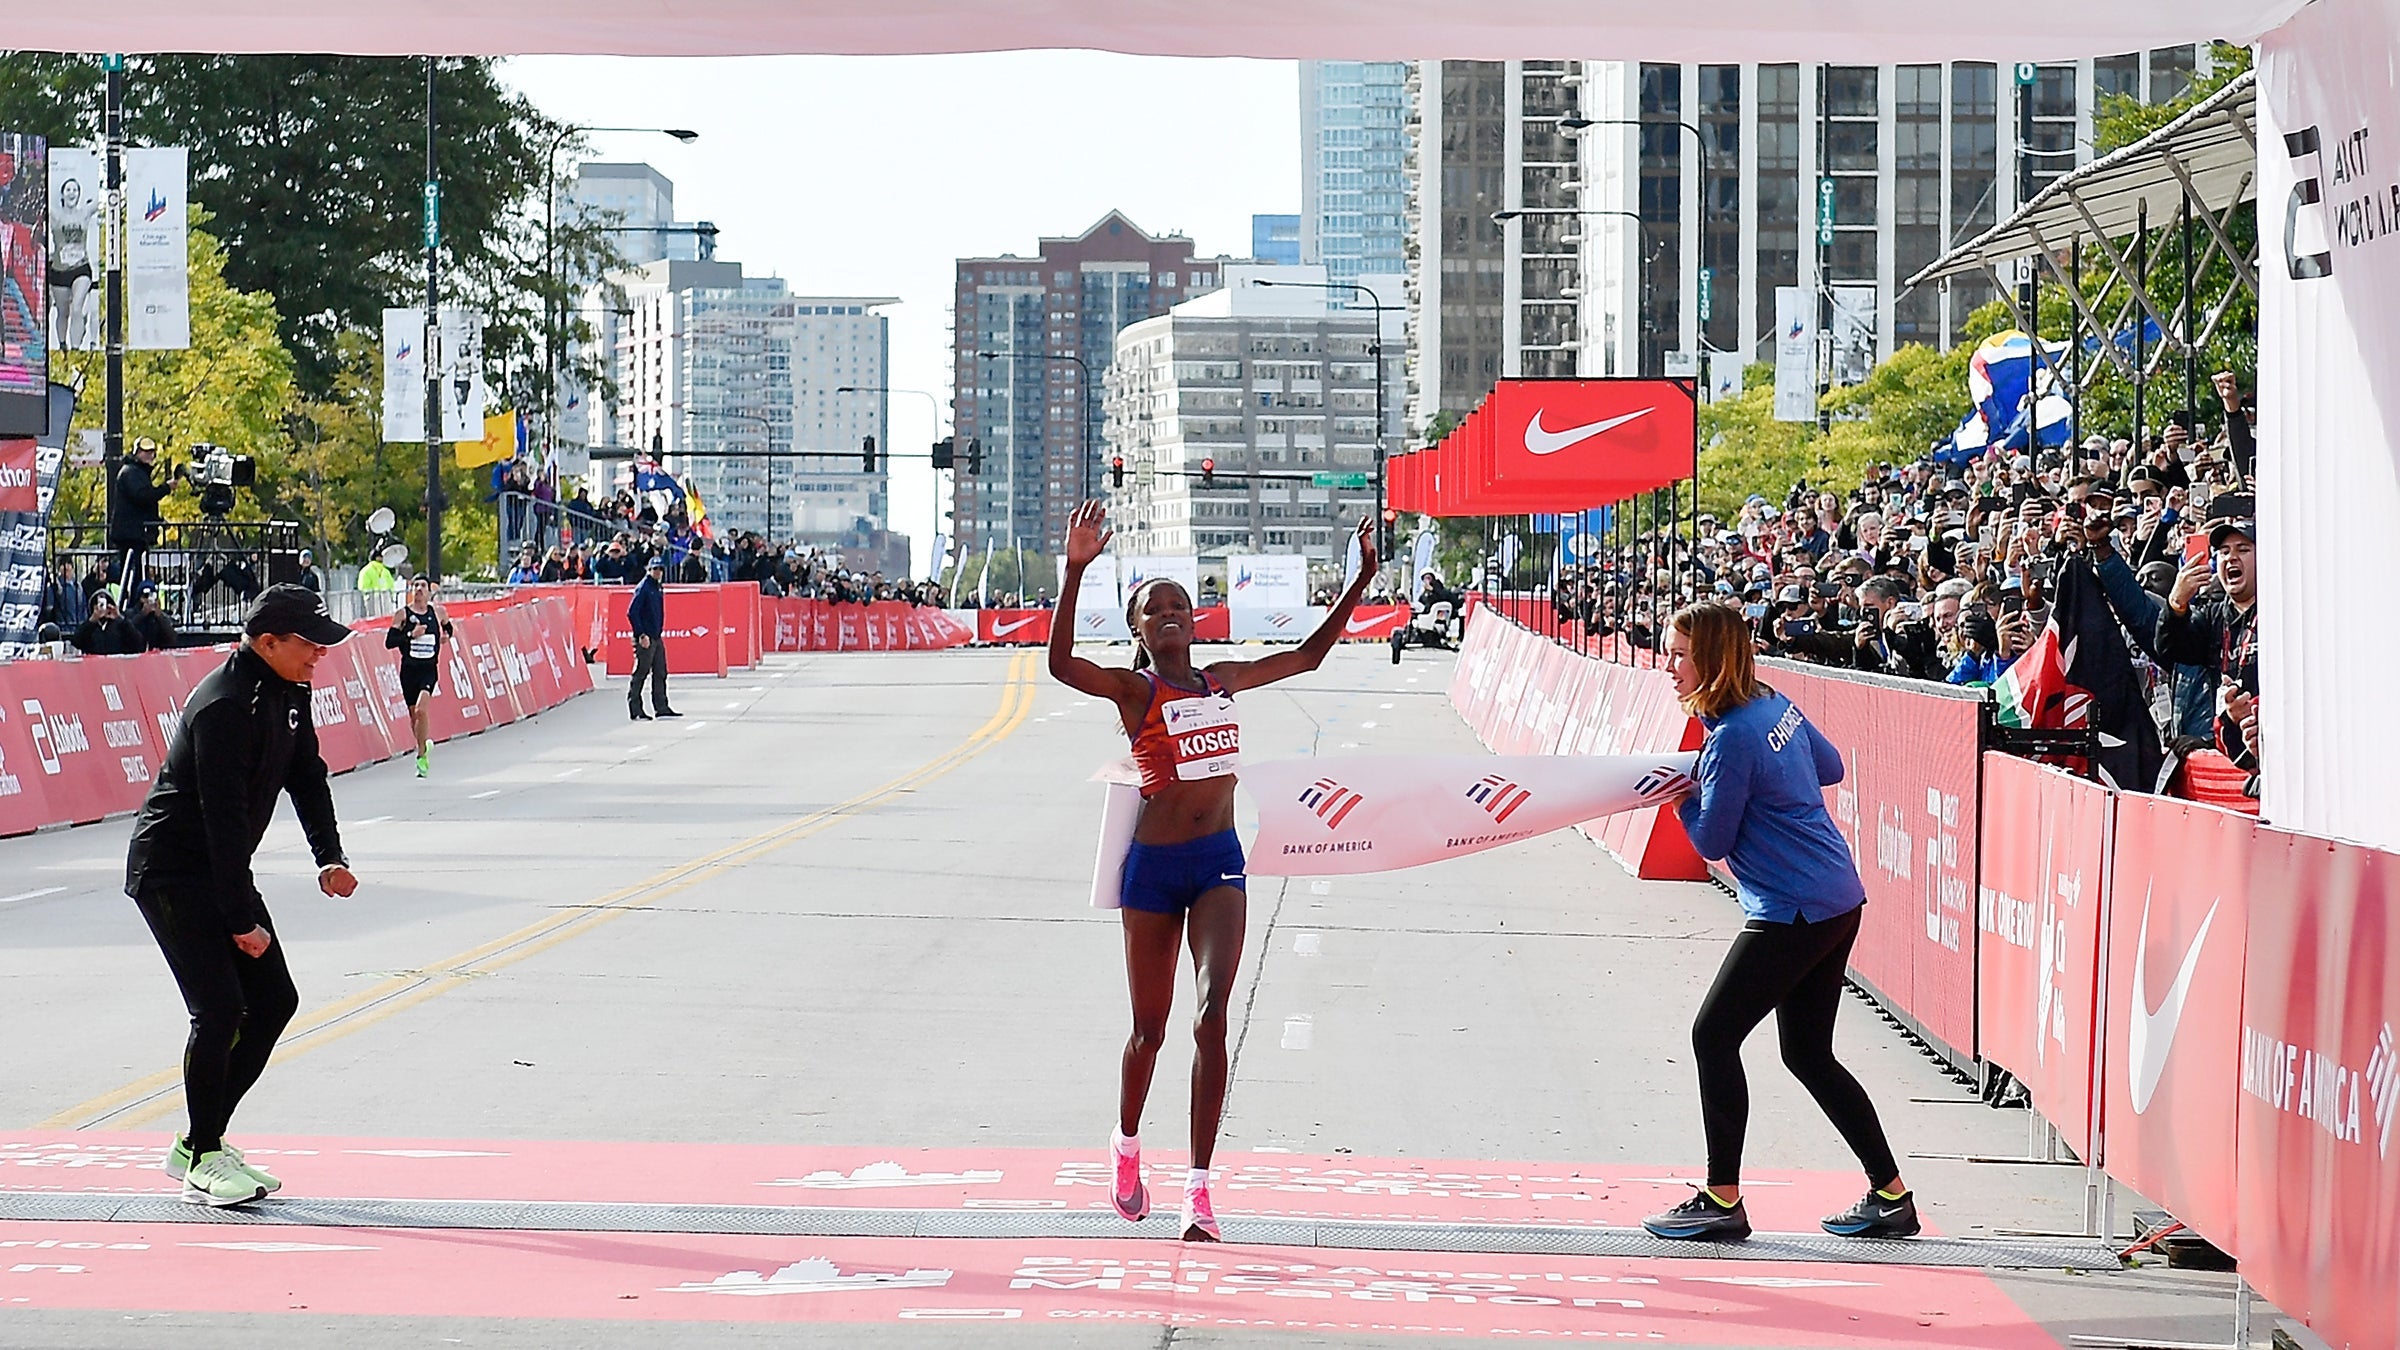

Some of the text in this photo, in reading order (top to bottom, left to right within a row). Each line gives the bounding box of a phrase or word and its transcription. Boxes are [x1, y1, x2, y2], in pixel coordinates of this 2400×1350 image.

[107, 192, 119, 266] C1111
[425, 184, 438, 245] C1121
[616, 630, 691, 639] BAN ERICA
[1282, 840, 1373, 855] BANK OF AMERICA
[1447, 837, 1474, 848] BANK
[1476, 835, 1490, 845] OF
[2273, 1040, 2298, 1112] OF
[1014, 1266, 1518, 1293] Chicago
[1022, 1255, 1659, 1285] Bank of America
[1009, 1277, 1645, 1309] Marathon
